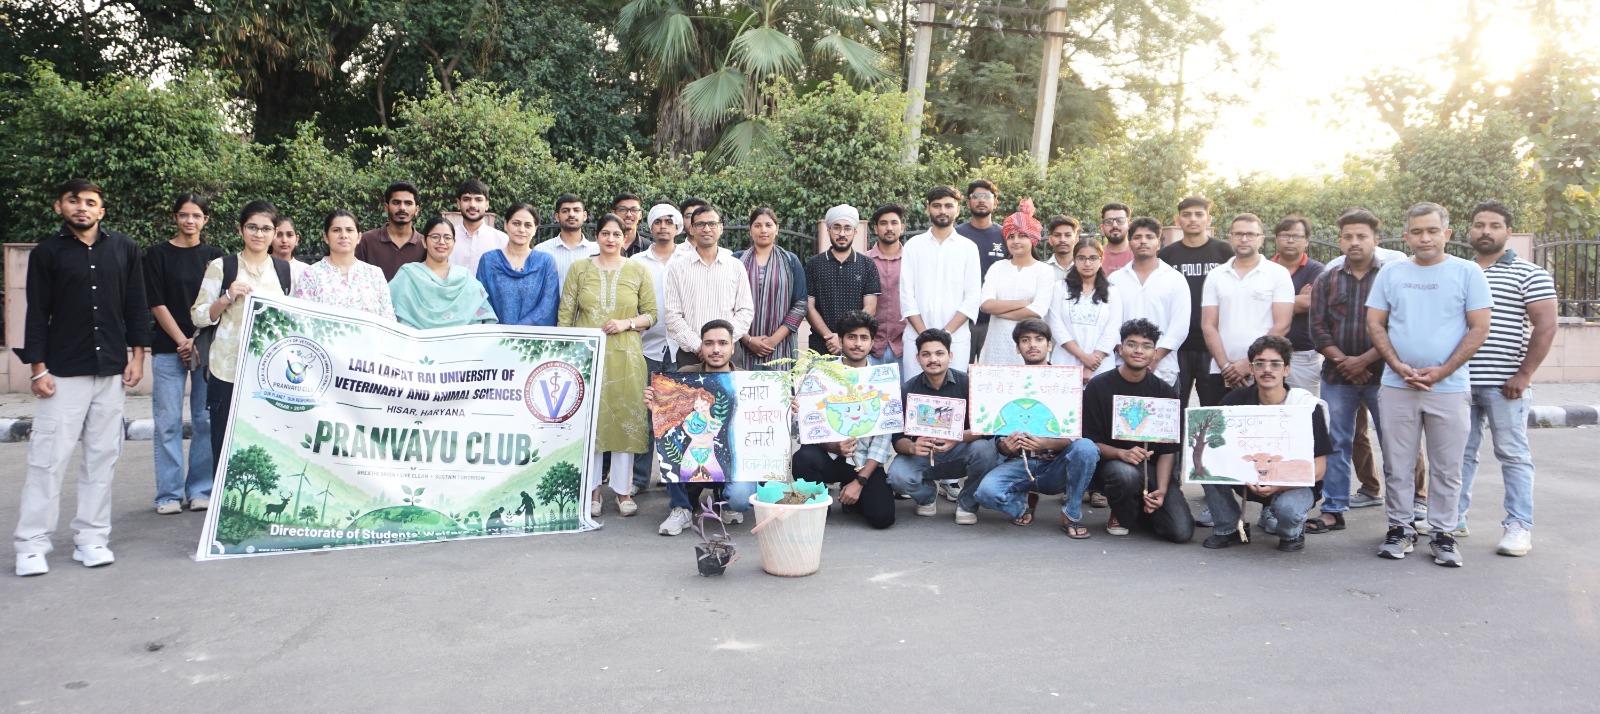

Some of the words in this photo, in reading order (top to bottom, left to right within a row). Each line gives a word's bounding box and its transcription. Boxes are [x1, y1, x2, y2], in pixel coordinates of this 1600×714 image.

[1181, 263, 1202, 276] POLO
[348, 357, 375, 375] LALA
[417, 371, 437, 384] RAI
[439, 369, 499, 384] UNIVERSITY
[501, 368, 516, 381] OF
[273, 381, 302, 392] PRANVAYU
[334, 376, 404, 398] VETERINARY
[406, 387, 430, 402] AND
[432, 389, 470, 402] ANIMAL
[472, 388, 523, 402] SCIENCES
[740, 385, 770, 401] हमारा
[386, 404, 418, 417] HISAR,
[420, 407, 466, 418] HARYANA
[743, 405, 782, 426] पर्यावरण
[312, 418, 459, 465] PRANVAYU
[464, 430, 533, 467] CLUB
[744, 425, 775, 447] हमारी
[270, 523, 343, 540] Directorate
[346, 528, 360, 540] of
